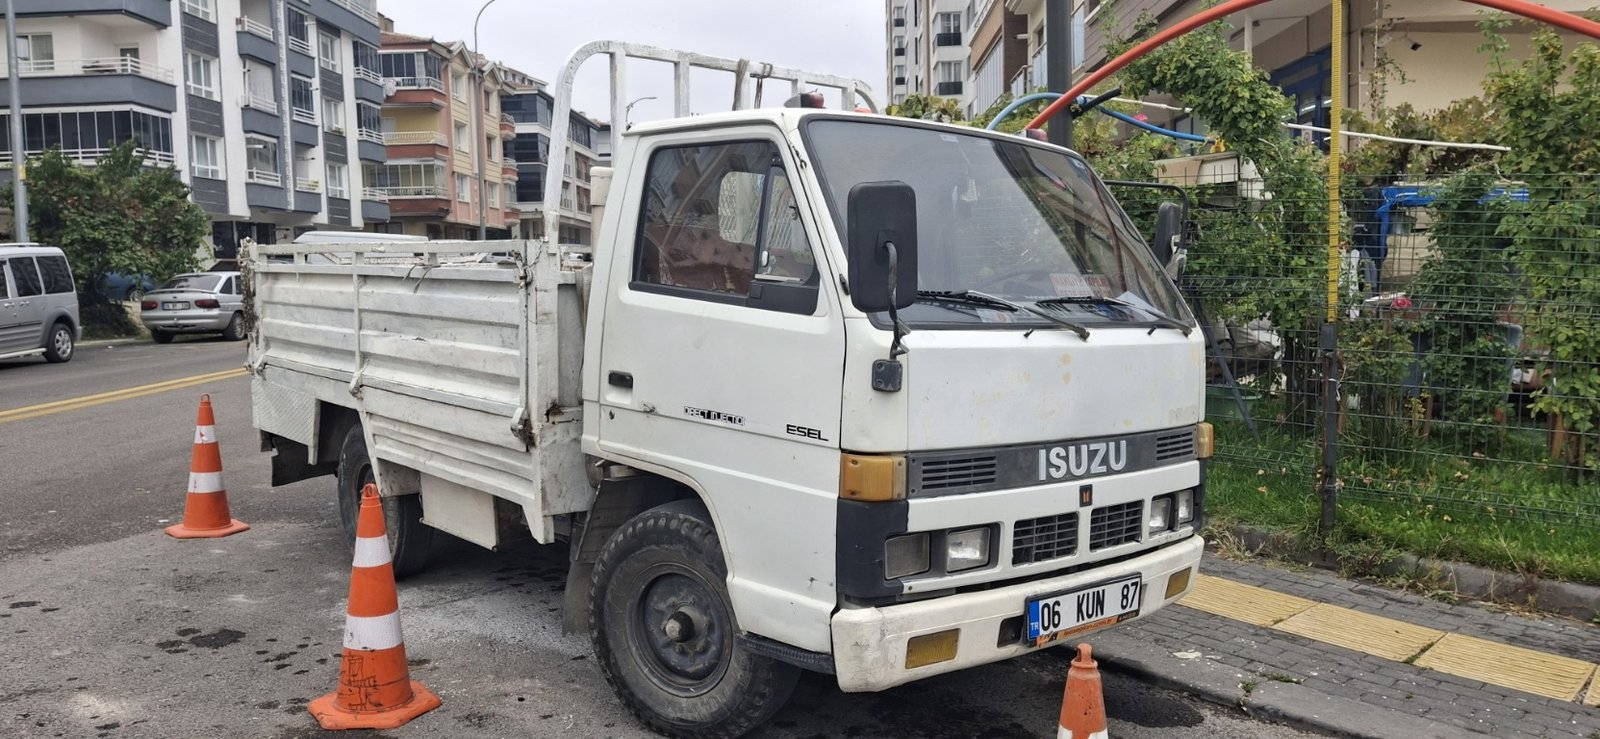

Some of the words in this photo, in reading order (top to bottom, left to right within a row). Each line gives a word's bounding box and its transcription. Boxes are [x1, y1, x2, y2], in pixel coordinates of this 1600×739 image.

[786, 424, 829, 441] ESEL
[1038, 440, 1127, 481] ISUZU
[1041, 601, 1060, 631] 06
[1076, 588, 1105, 622] KUN
[1120, 581, 1139, 610] 87
[1030, 621, 1040, 631] TR
